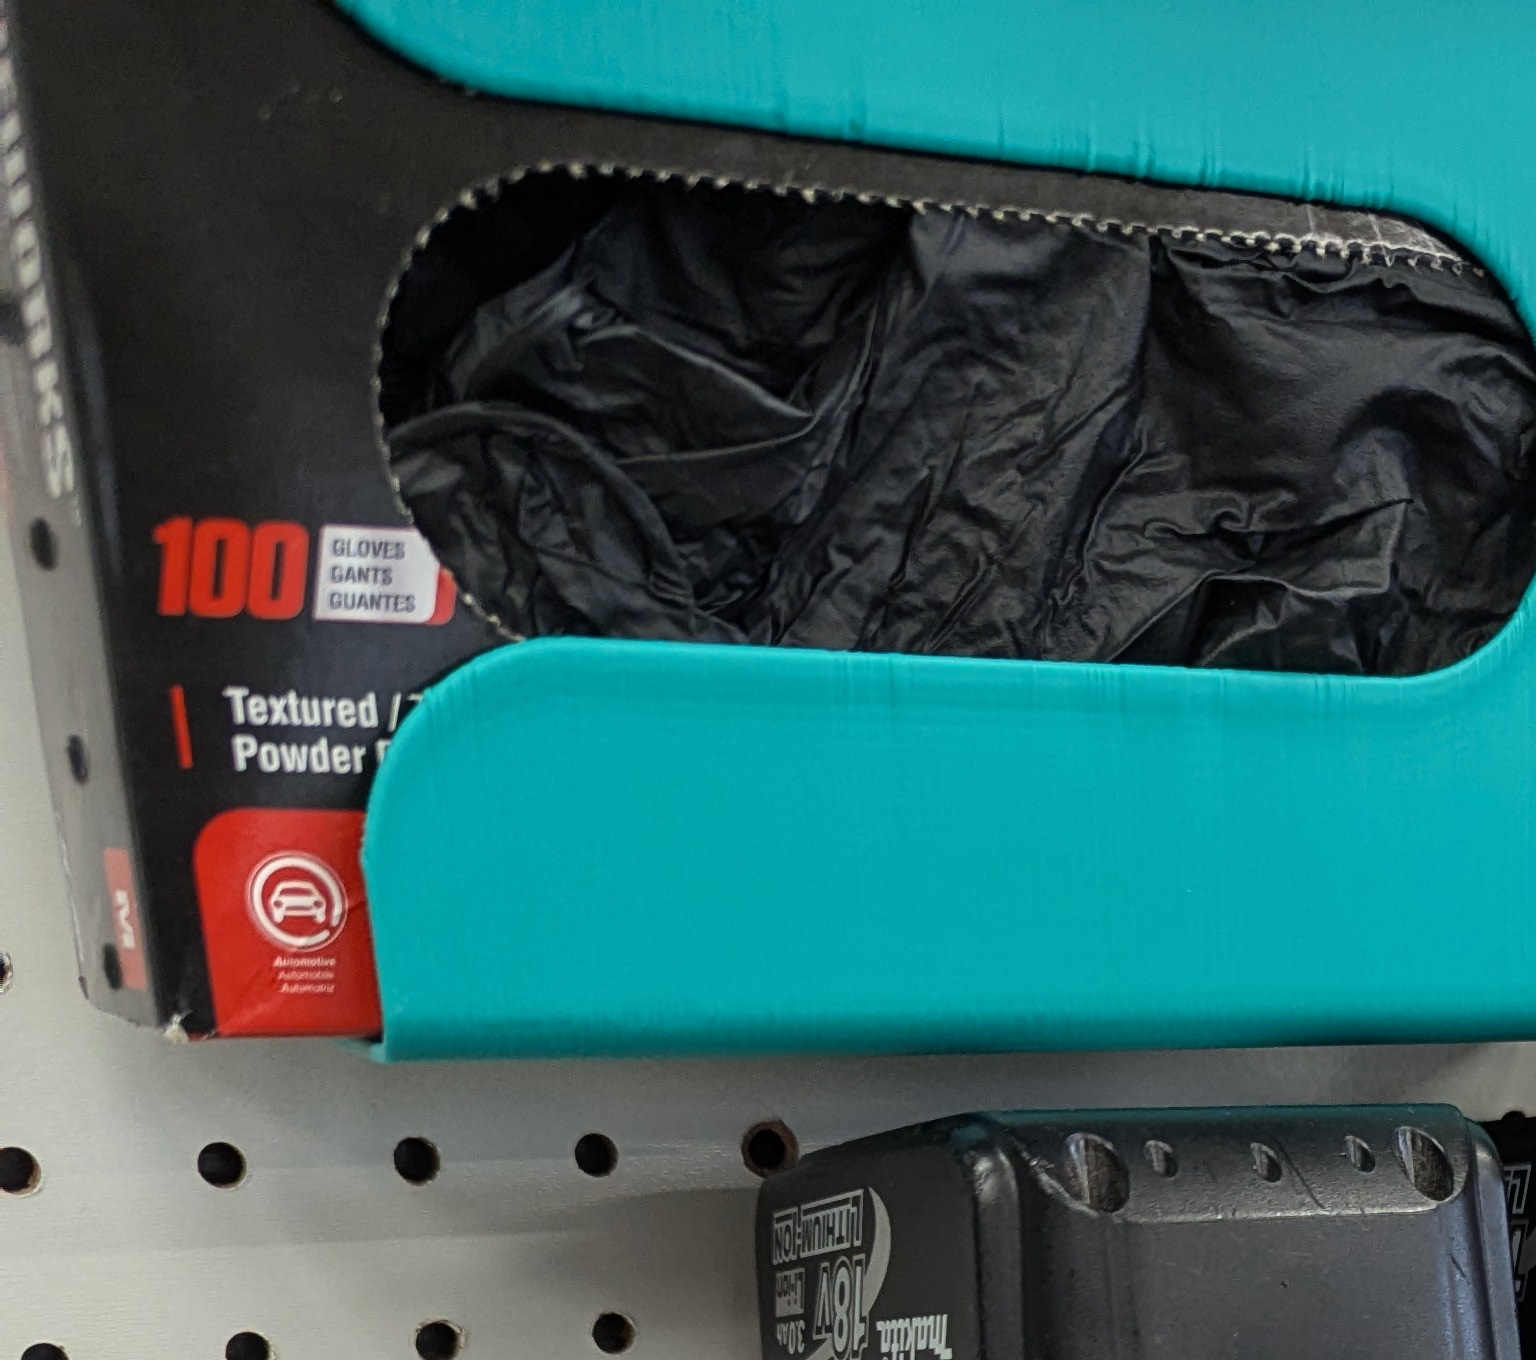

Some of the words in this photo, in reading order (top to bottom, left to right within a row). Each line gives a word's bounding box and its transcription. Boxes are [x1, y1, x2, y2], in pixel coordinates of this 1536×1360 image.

[153, 516, 309, 620] 100
[332, 538, 406, 559] GLOVES
[330, 565, 393, 586] GANTS
[329, 592, 416, 613] GUANTES
[222, 685, 378, 729] Textured
[231, 733, 367, 774] Powder
[273, 956, 336, 967] Automotive
